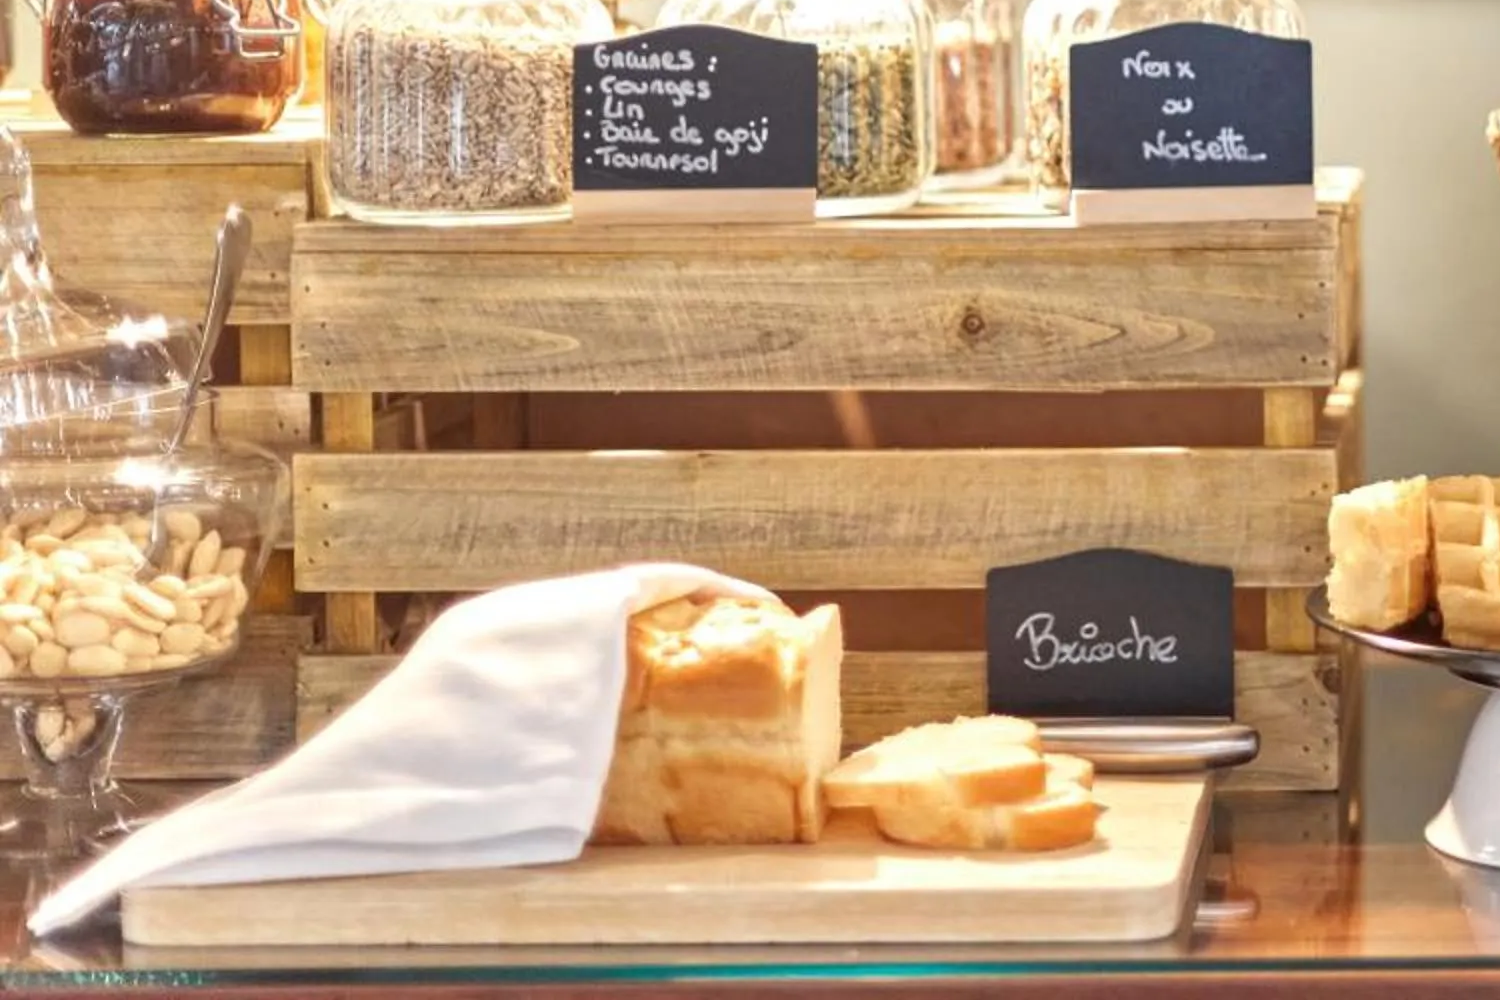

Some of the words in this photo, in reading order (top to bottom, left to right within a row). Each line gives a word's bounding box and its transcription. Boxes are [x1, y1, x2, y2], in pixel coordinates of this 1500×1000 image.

[600, 75, 711, 107] Courges
[1161, 97, 1193, 115] ou
[603, 97, 644, 121] Lin
[600, 120, 660, 145] Baie
[669, 115, 703, 146] de
[714, 116, 769, 156] goji
[1142, 126, 1267, 162] Noisette
[594, 147, 718, 174] Tournesol
[1015, 612, 1178, 670] Brioche
